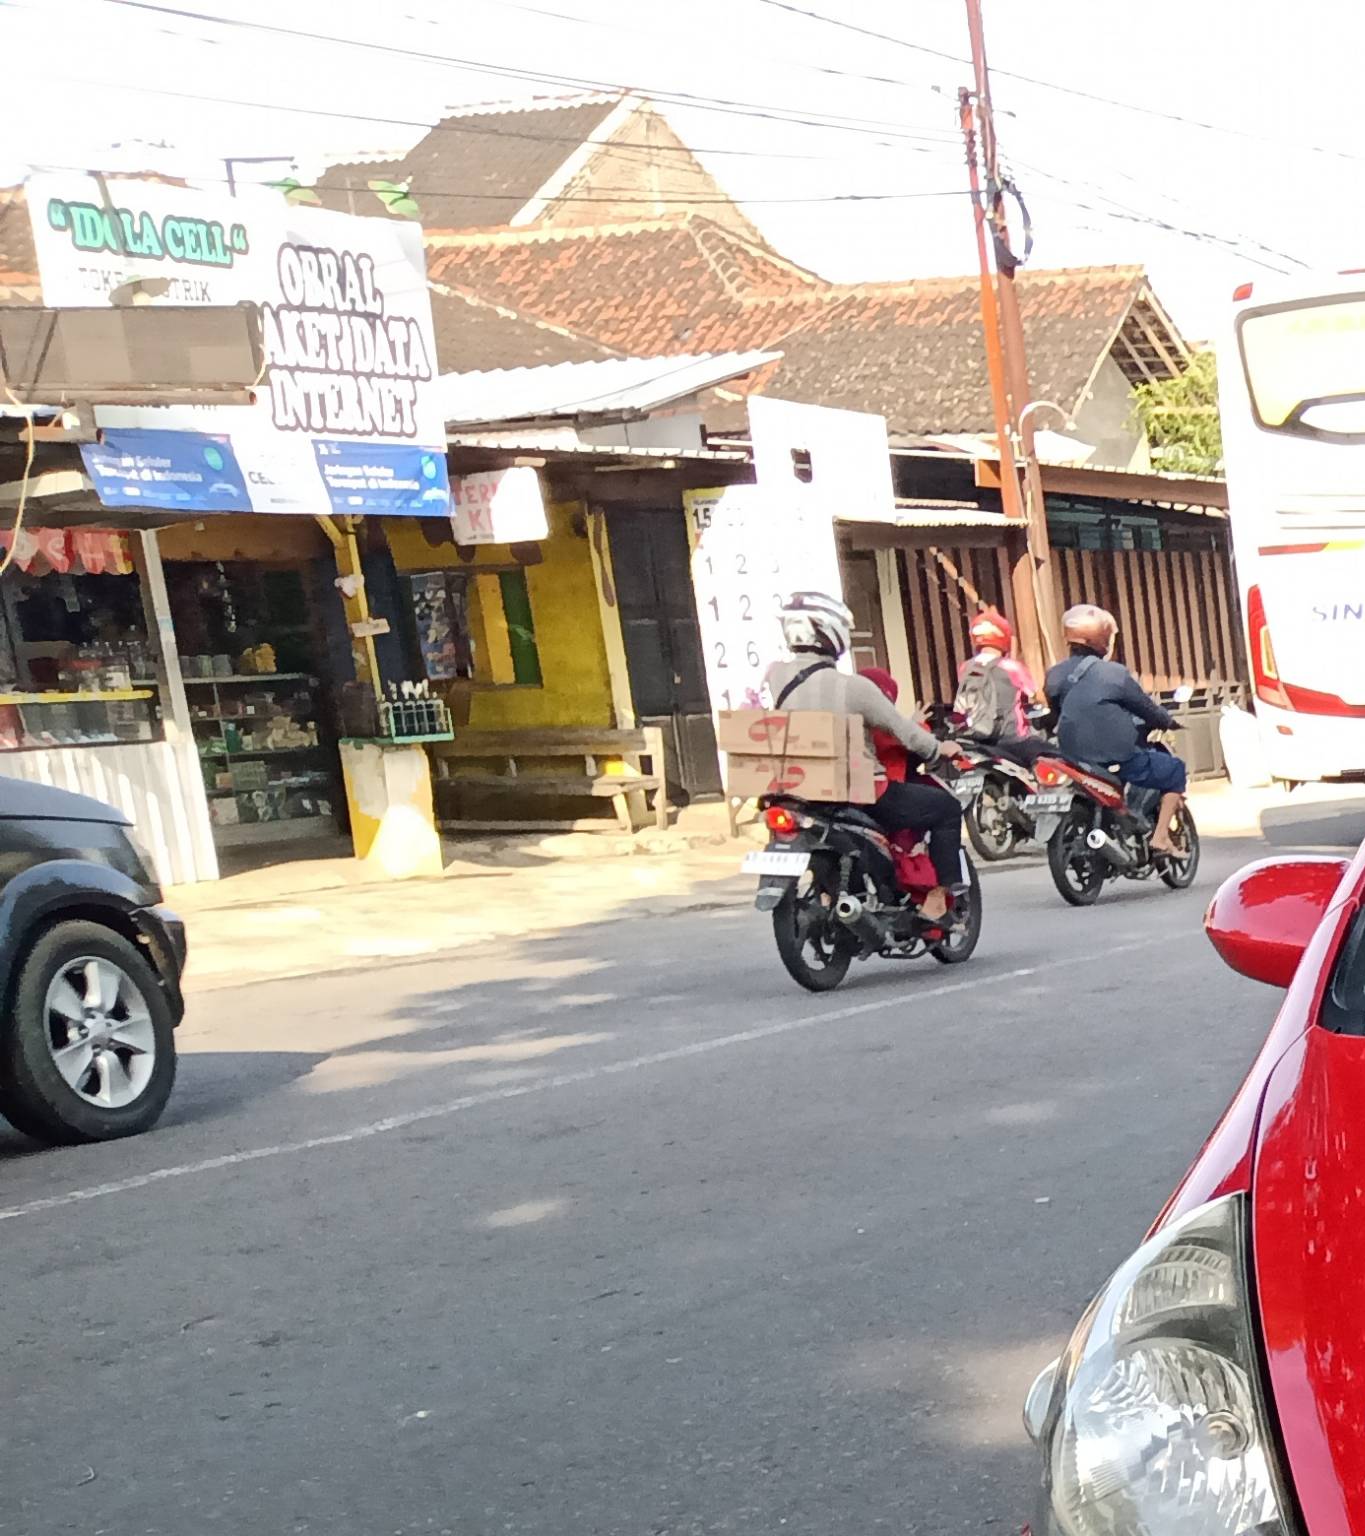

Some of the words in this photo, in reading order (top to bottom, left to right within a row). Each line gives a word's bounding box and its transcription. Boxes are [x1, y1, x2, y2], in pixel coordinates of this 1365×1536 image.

[278, 242, 383, 318] OBRAL
[261, 302, 342, 372] AKET
[268, 369, 418, 438] INTERNET
